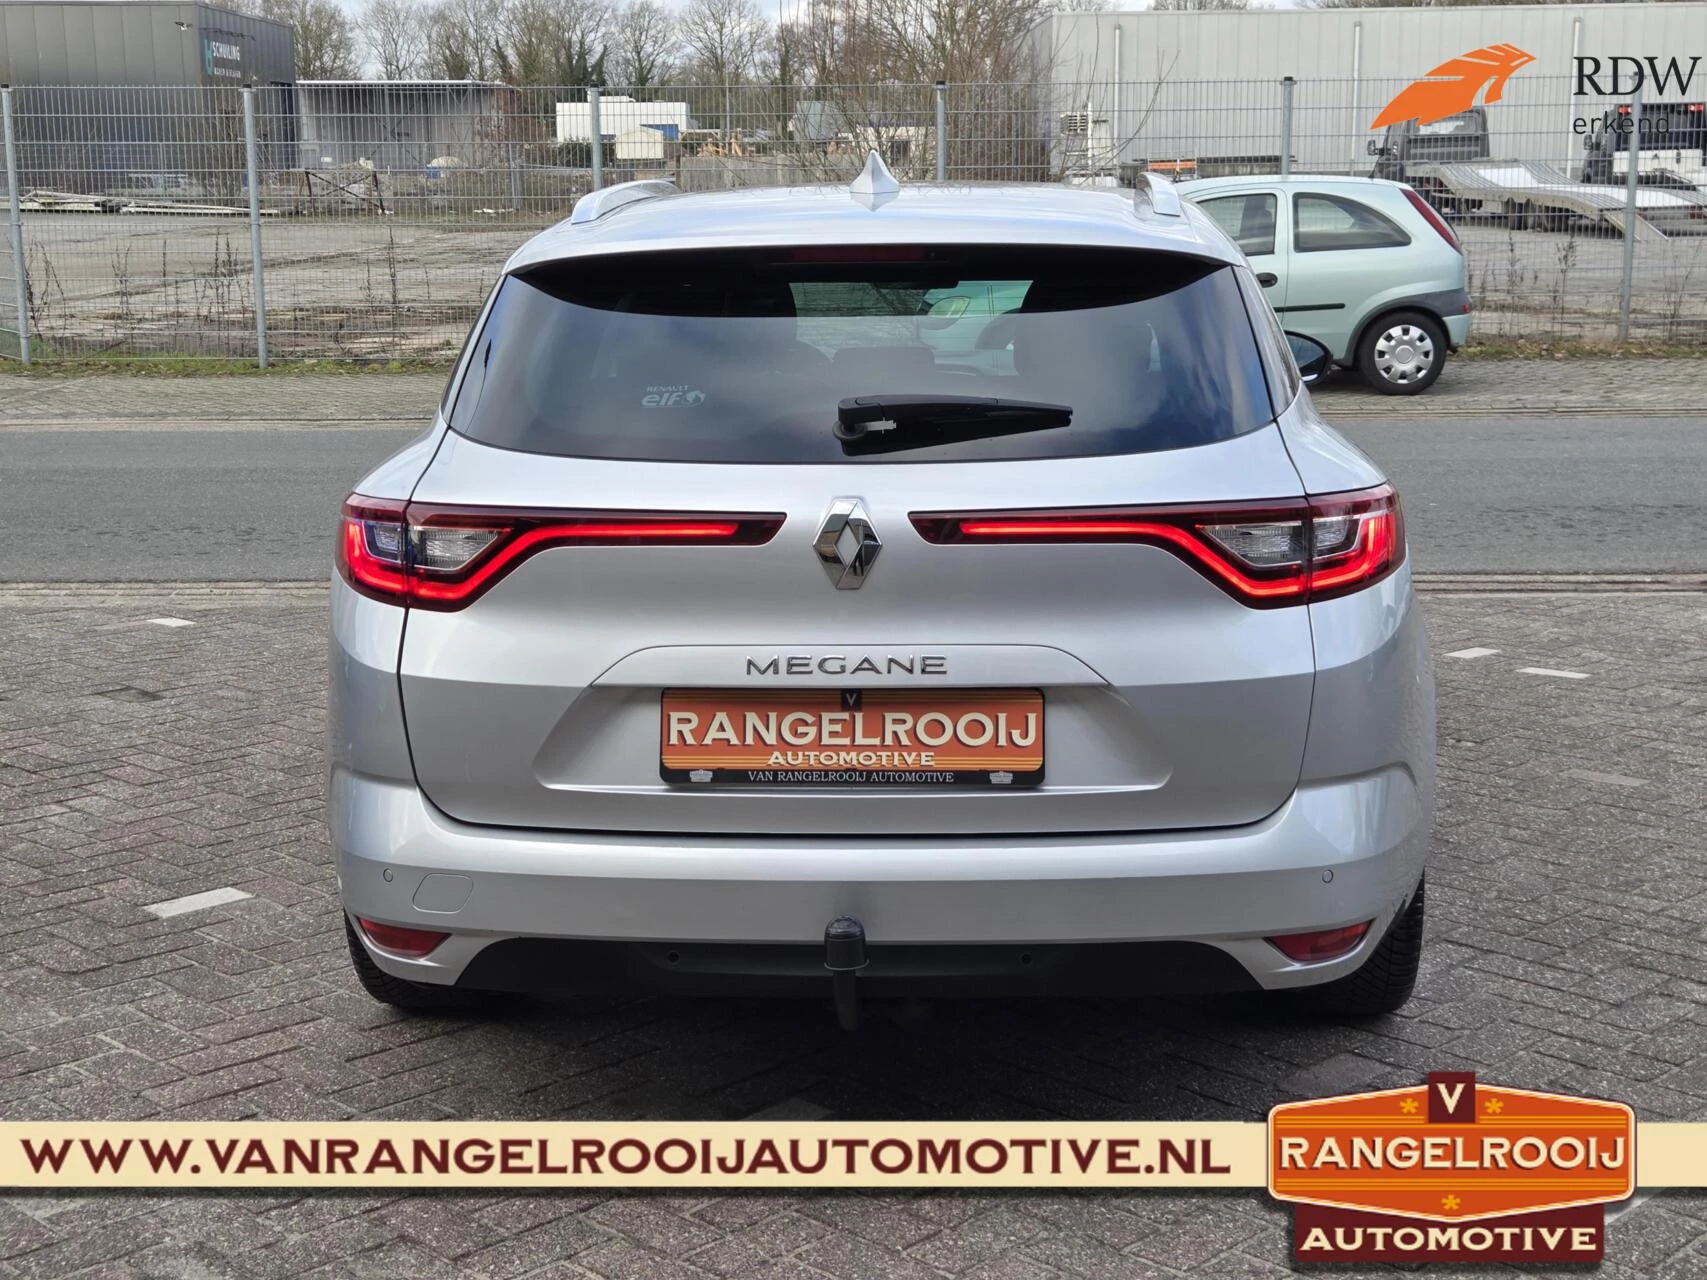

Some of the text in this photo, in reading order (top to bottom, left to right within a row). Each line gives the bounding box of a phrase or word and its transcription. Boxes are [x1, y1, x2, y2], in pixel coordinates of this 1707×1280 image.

[647, 385, 689, 393] RENAULT
[641, 392, 683, 406] elf
[746, 655, 948, 675] MEGANE
[845, 692, 858, 708] V
[668, 711, 1038, 747] RANGELROOIJ
[767, 751, 935, 767] AUTOMOTIVE
[748, 771, 955, 783] VAN RANGELROOIJ AUTOMOTIVE
